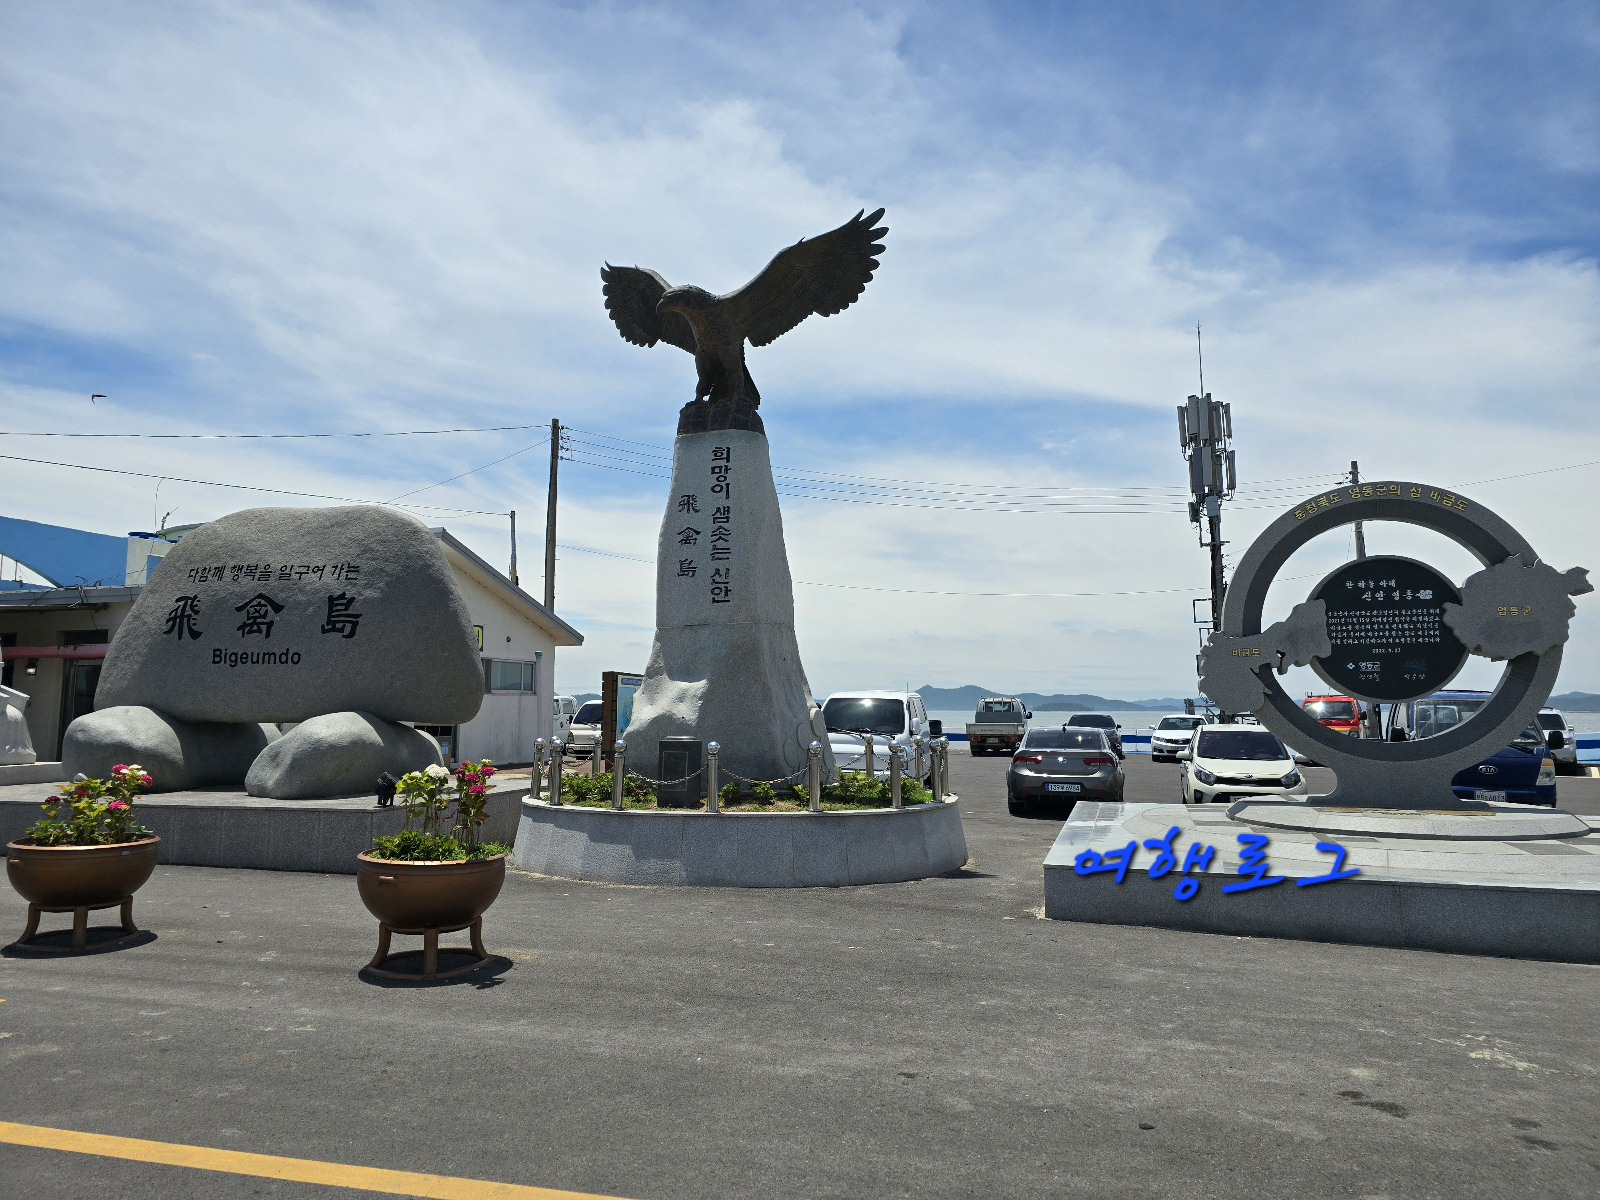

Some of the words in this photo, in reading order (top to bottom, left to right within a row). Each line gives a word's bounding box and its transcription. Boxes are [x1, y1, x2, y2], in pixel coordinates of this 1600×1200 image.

[710, 446, 732, 501] 희망이
[1293, 492, 1343, 520] 충청북도
[1348, 484, 1401, 499] 영동군의
[1409, 486, 1422, 498] 섬
[1429, 490, 1471, 512] 비금도
[676, 493, 702, 579] 飛禽島
[709, 505, 732, 562] 샘솟는
[188, 563, 227, 584] 다함께
[230, 562, 273, 583] 행복을
[277, 563, 326, 583] 일구어
[331, 561, 360, 581] 가는
[709, 566, 732, 605] 신안
[1361, 590, 1386, 602] 신안
[1496, 604, 1533, 616] 영동군
[162, 591, 363, 641] 飛禽島
[211, 647, 303, 669] Bigeumdo
[1231, 647, 1261, 658] 비금도
[1358, 661, 1381, 669] 영동군
